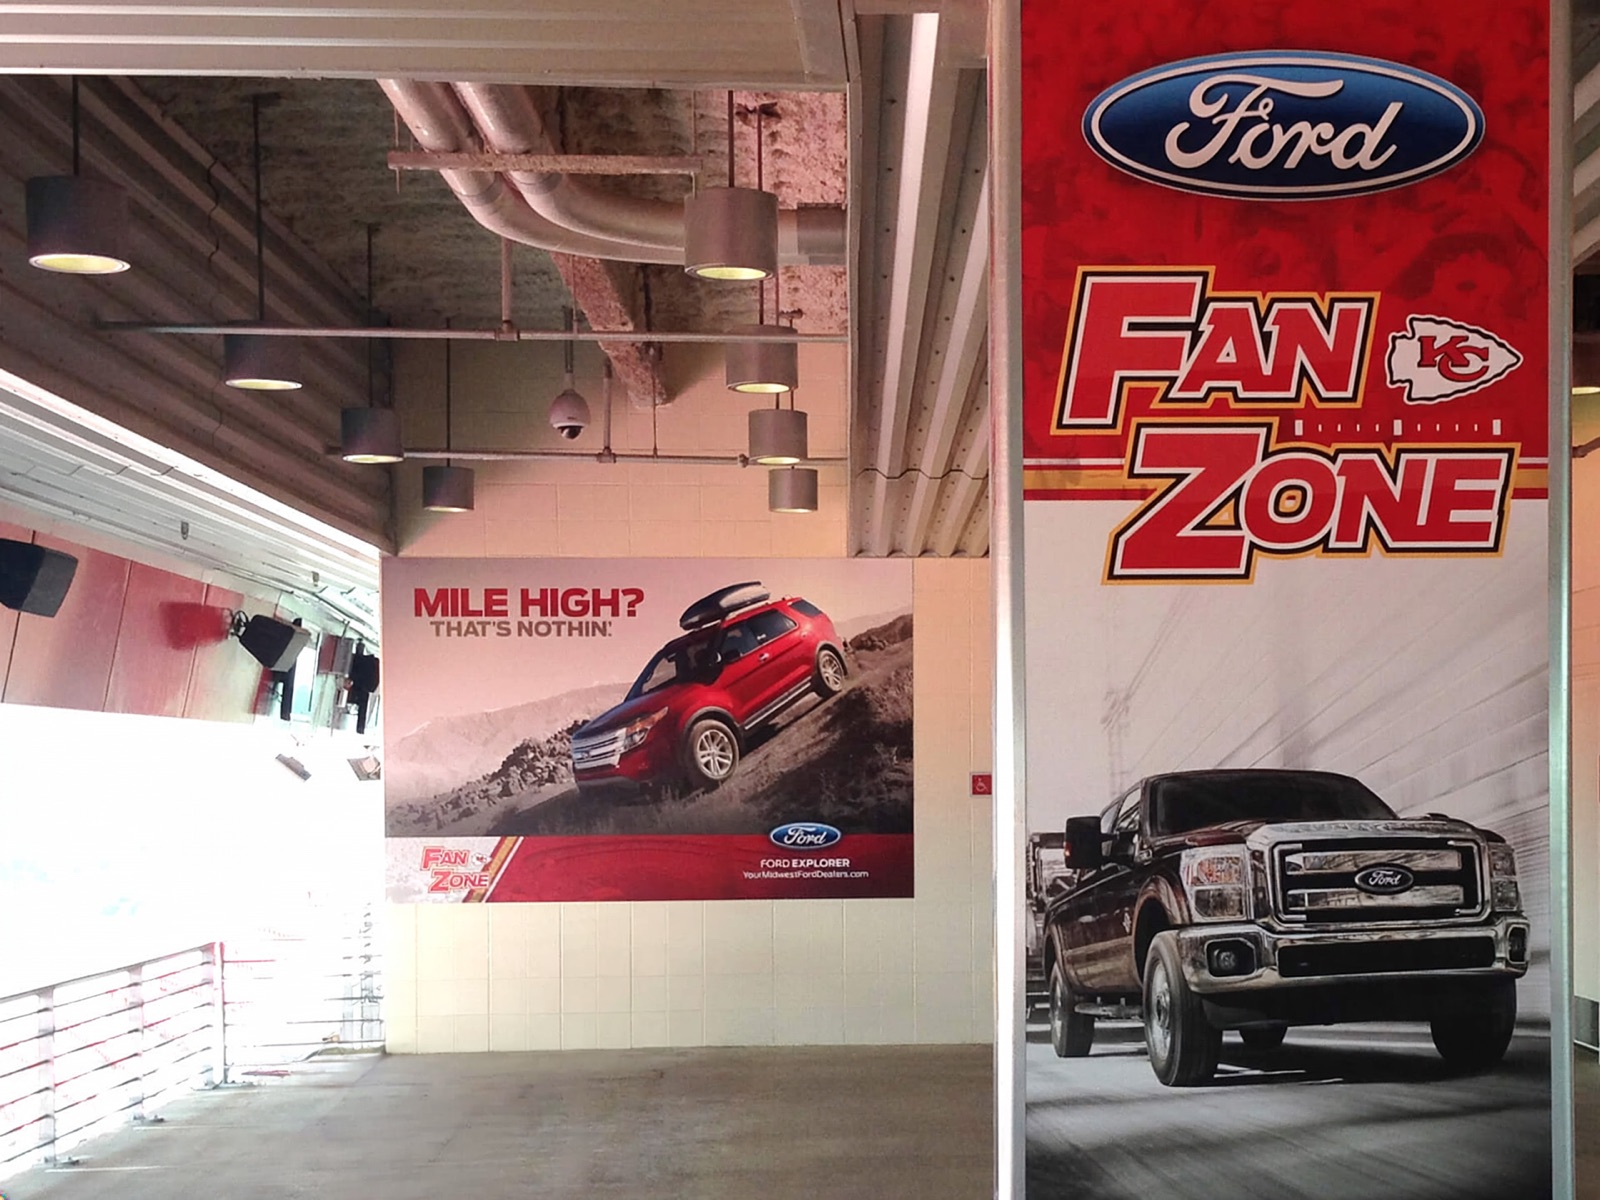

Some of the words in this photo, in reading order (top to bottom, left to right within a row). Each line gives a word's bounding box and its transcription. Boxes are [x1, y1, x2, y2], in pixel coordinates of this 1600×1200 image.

[1164, 73, 1404, 171] Ford
[1055, 269, 1376, 432] FAN
[1417, 335, 1490, 382] KC
[1105, 420, 1517, 582] ZONE
[413, 587, 509, 618] MILE
[519, 587, 645, 618] HIGH?
[429, 620, 512, 638] THAT'S
[784, 826, 827, 844] Ford
[421, 847, 470, 871] FAN
[760, 859, 790, 868] FORD
[791, 858, 851, 868] EXPLORER
[429, 869, 489, 893] ZONE
[1368, 870, 1401, 885] Ford
